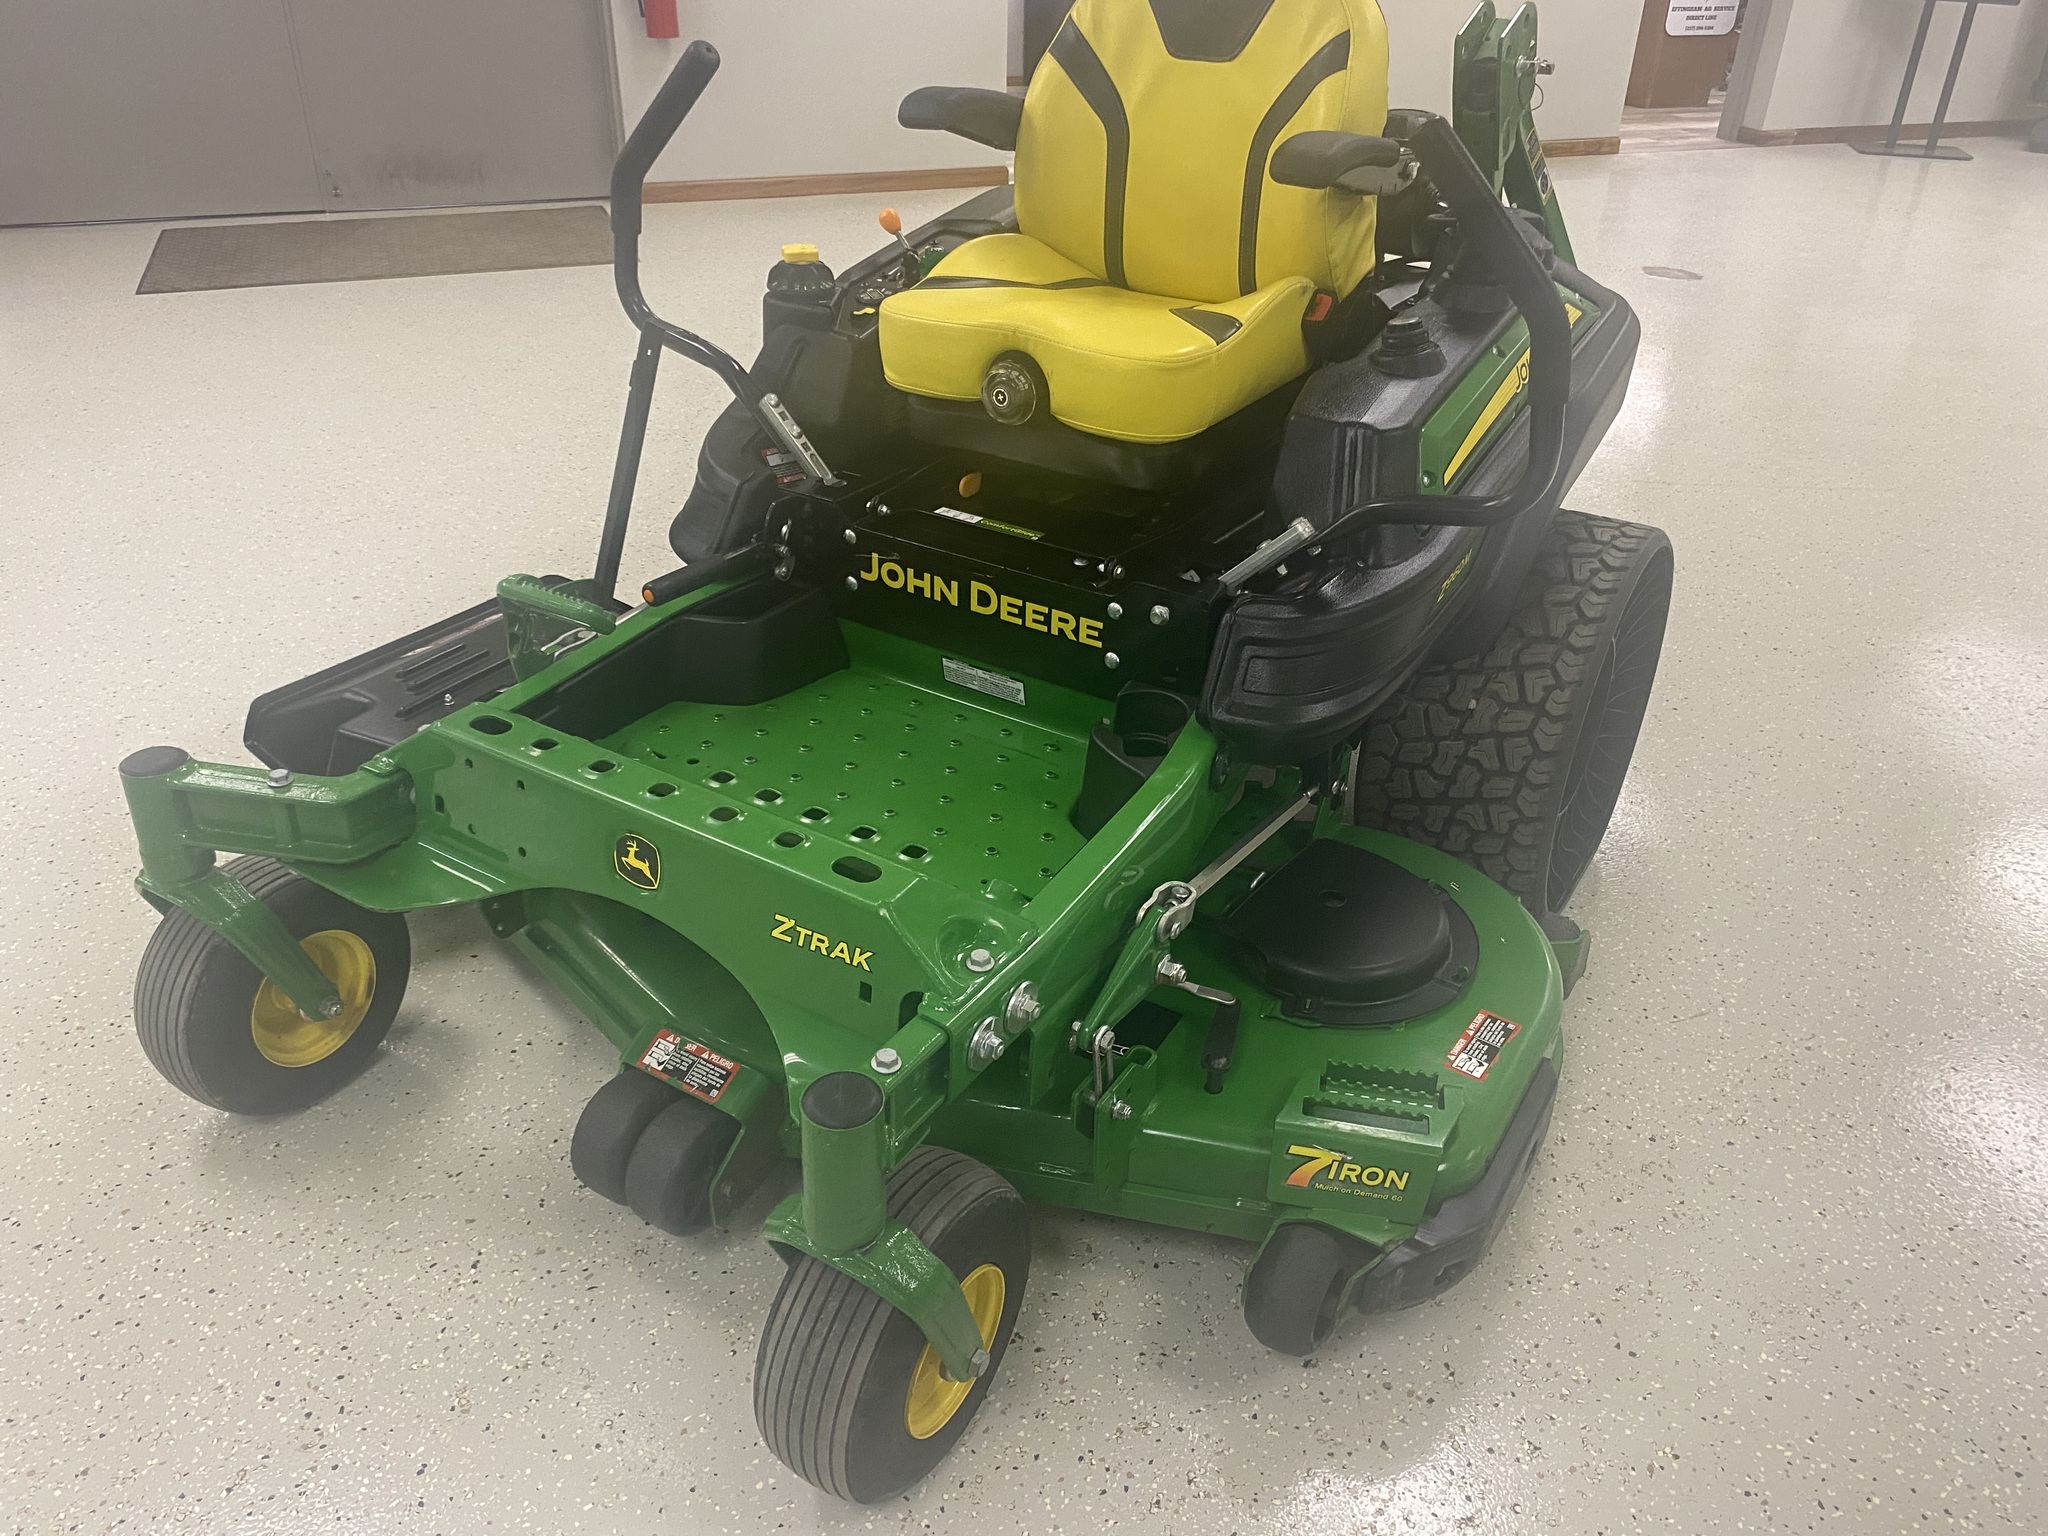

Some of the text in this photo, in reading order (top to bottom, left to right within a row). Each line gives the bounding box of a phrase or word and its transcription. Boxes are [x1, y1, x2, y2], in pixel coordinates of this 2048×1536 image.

[860, 552, 1104, 649] JOHN DEERE
[770, 913, 874, 973] ZTRAK
[708, 1053, 734, 1070] PELIGRO
[1314, 1182, 1339, 1193] Mulch
[1353, 1189, 1389, 1201] Demand
